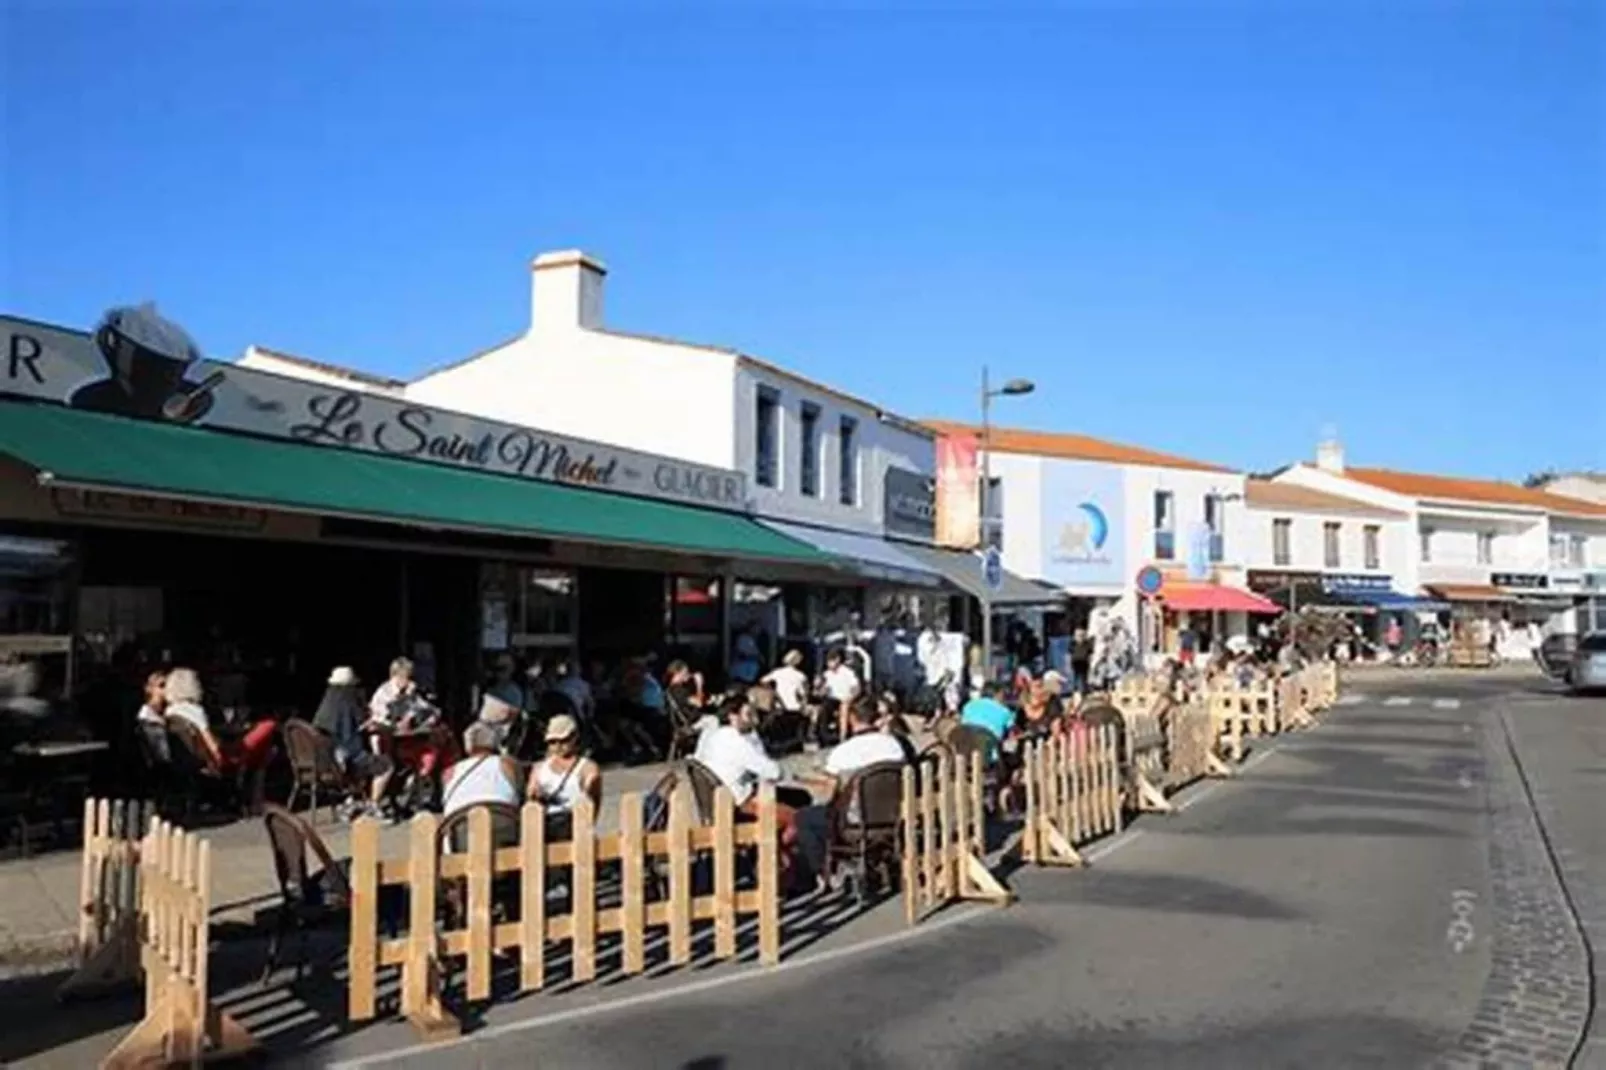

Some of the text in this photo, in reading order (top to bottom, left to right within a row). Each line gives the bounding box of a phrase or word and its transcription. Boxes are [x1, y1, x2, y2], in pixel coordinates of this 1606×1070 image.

[290, 390, 741, 502] Le Saint Michel GLACIER
